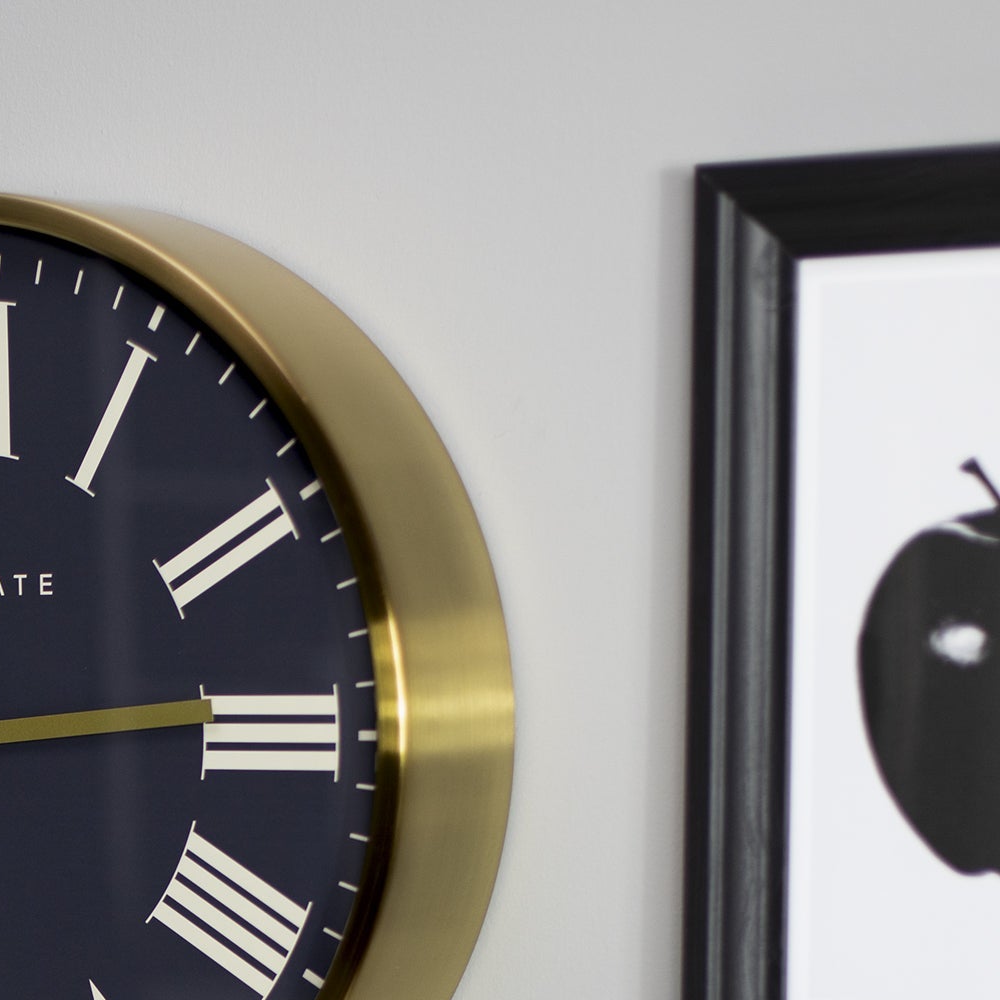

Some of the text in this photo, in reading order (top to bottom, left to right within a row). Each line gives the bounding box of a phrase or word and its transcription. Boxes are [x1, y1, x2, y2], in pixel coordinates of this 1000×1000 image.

[64, 340, 158, 497] I
[152, 477, 299, 619] II
[199, 684, 341, 783] III
